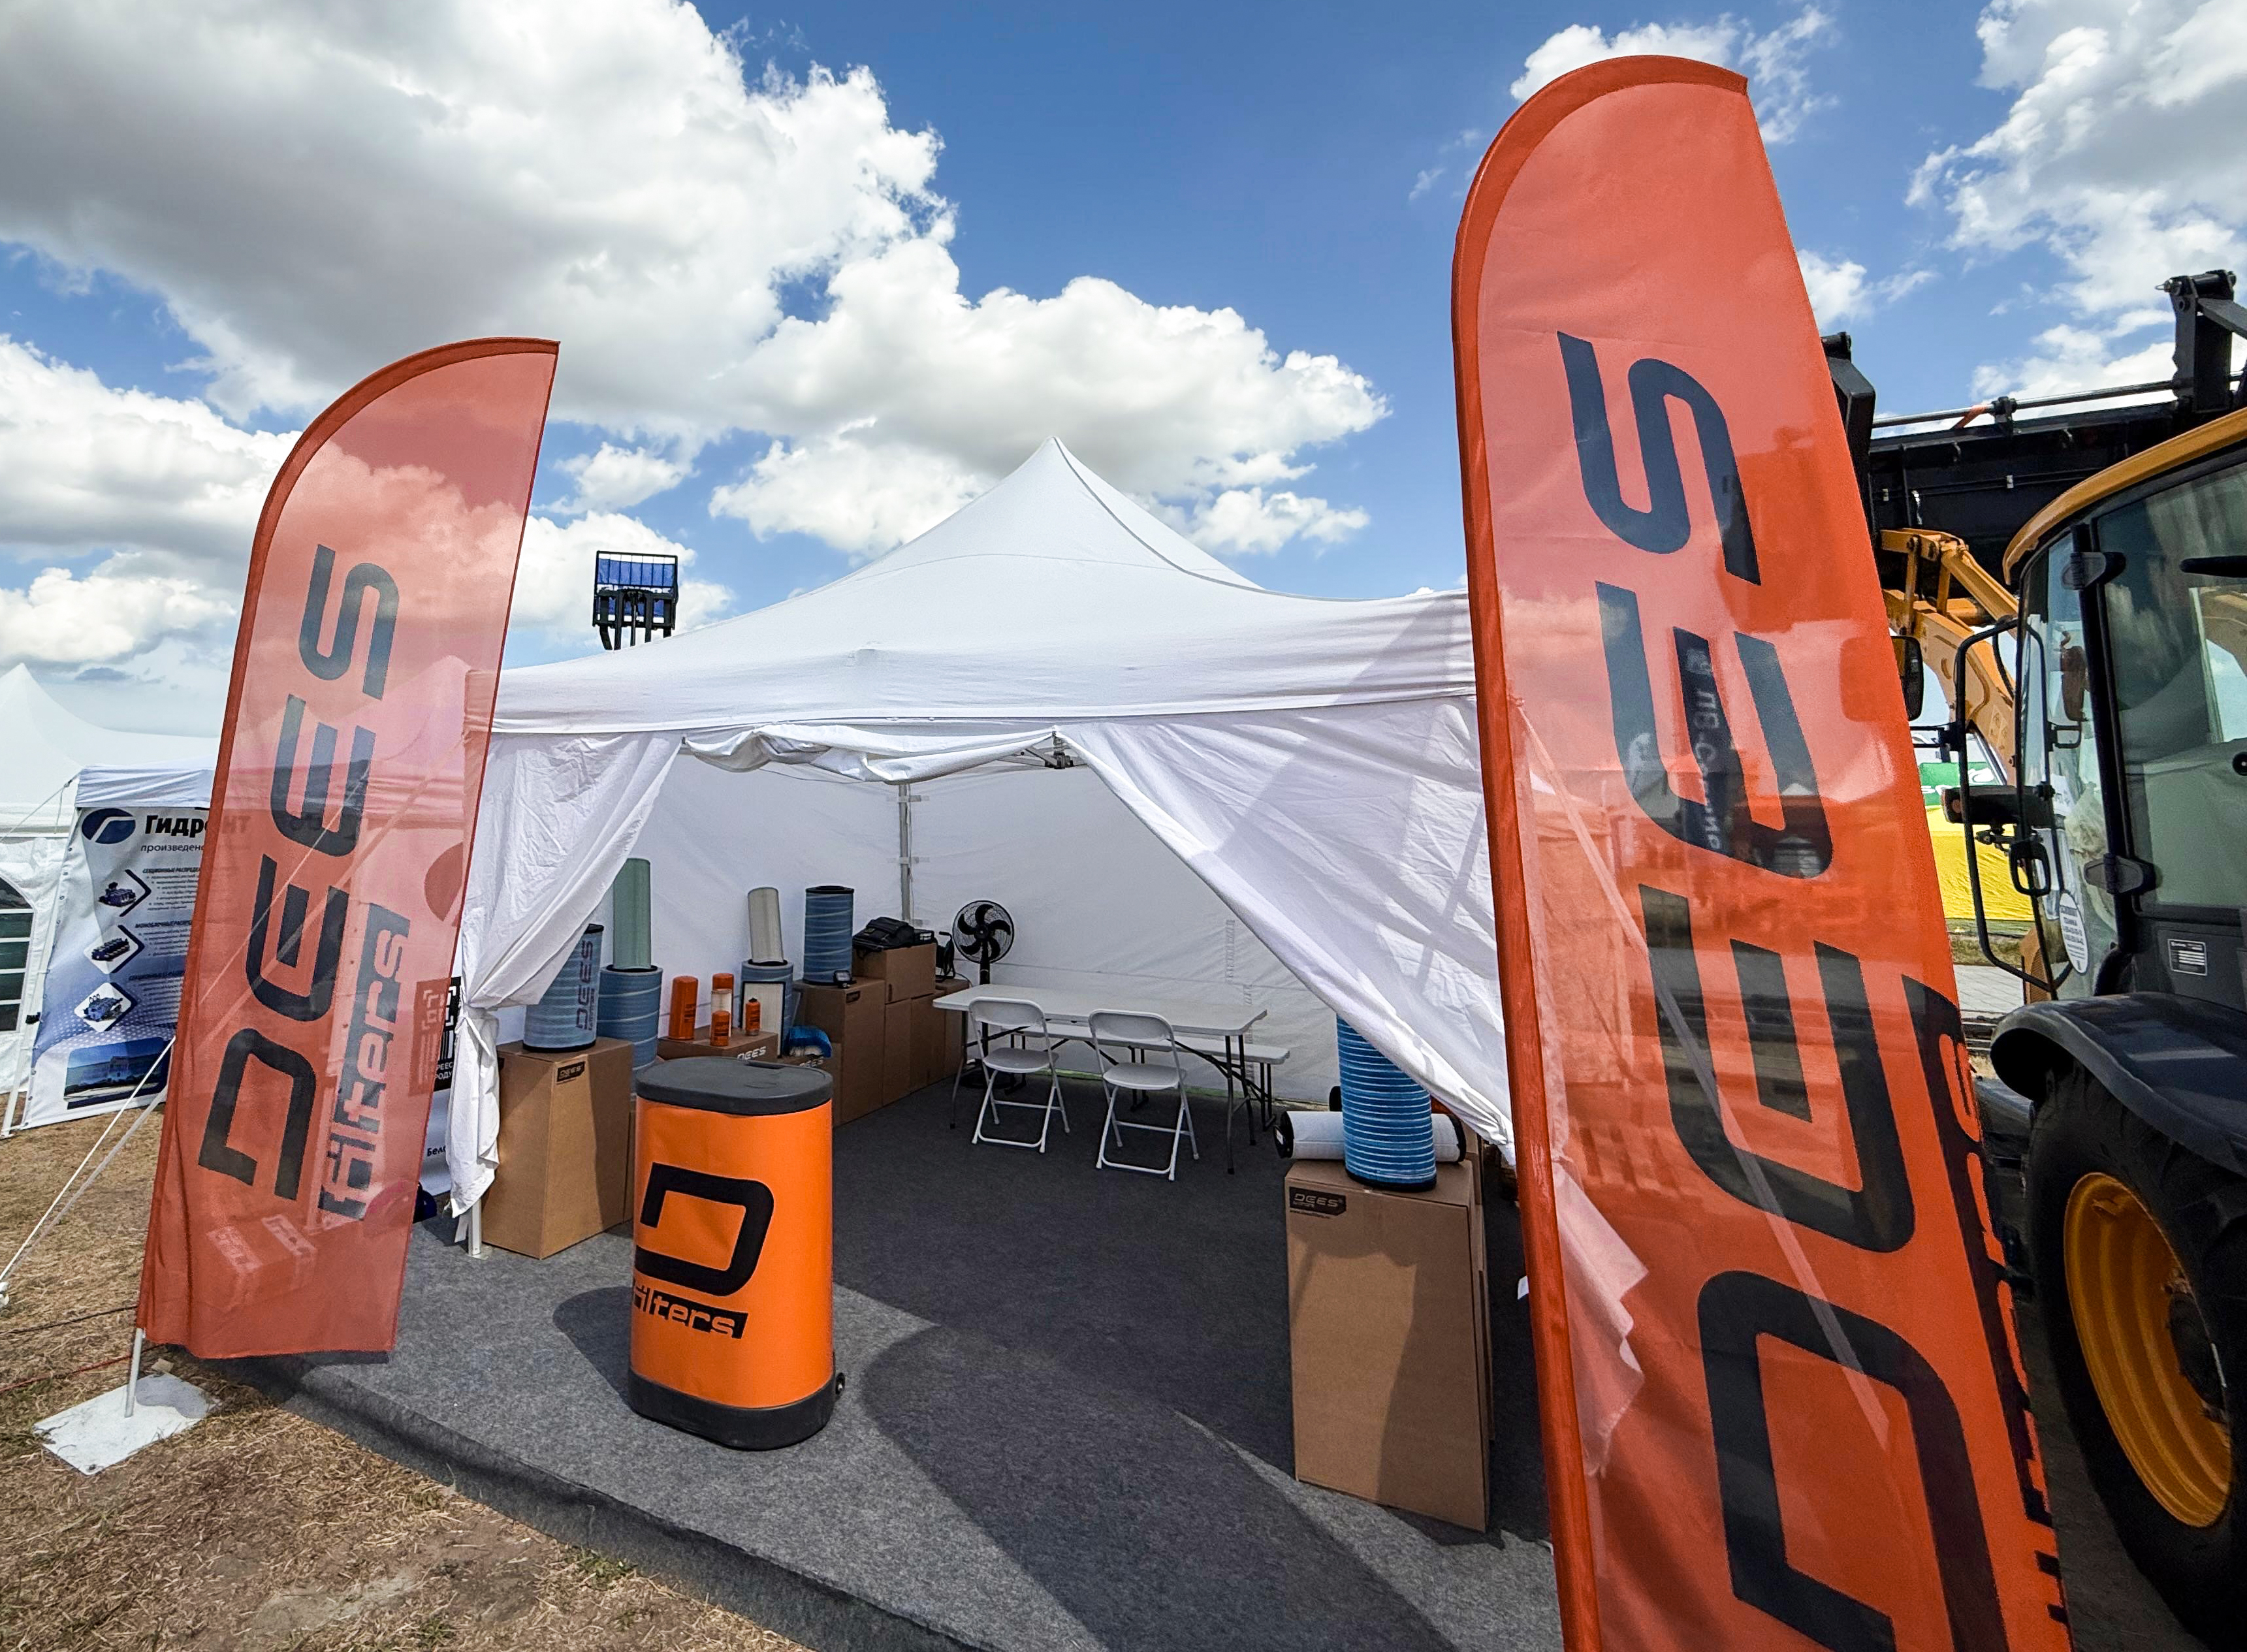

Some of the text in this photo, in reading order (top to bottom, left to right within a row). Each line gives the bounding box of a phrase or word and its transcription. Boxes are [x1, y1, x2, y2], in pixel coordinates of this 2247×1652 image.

[199, 544, 399, 1200] DEES
[321, 919, 407, 1212] filters
[1557, 331, 2008, 1652] DEES
[1294, 1193, 1339, 1207] DEES
